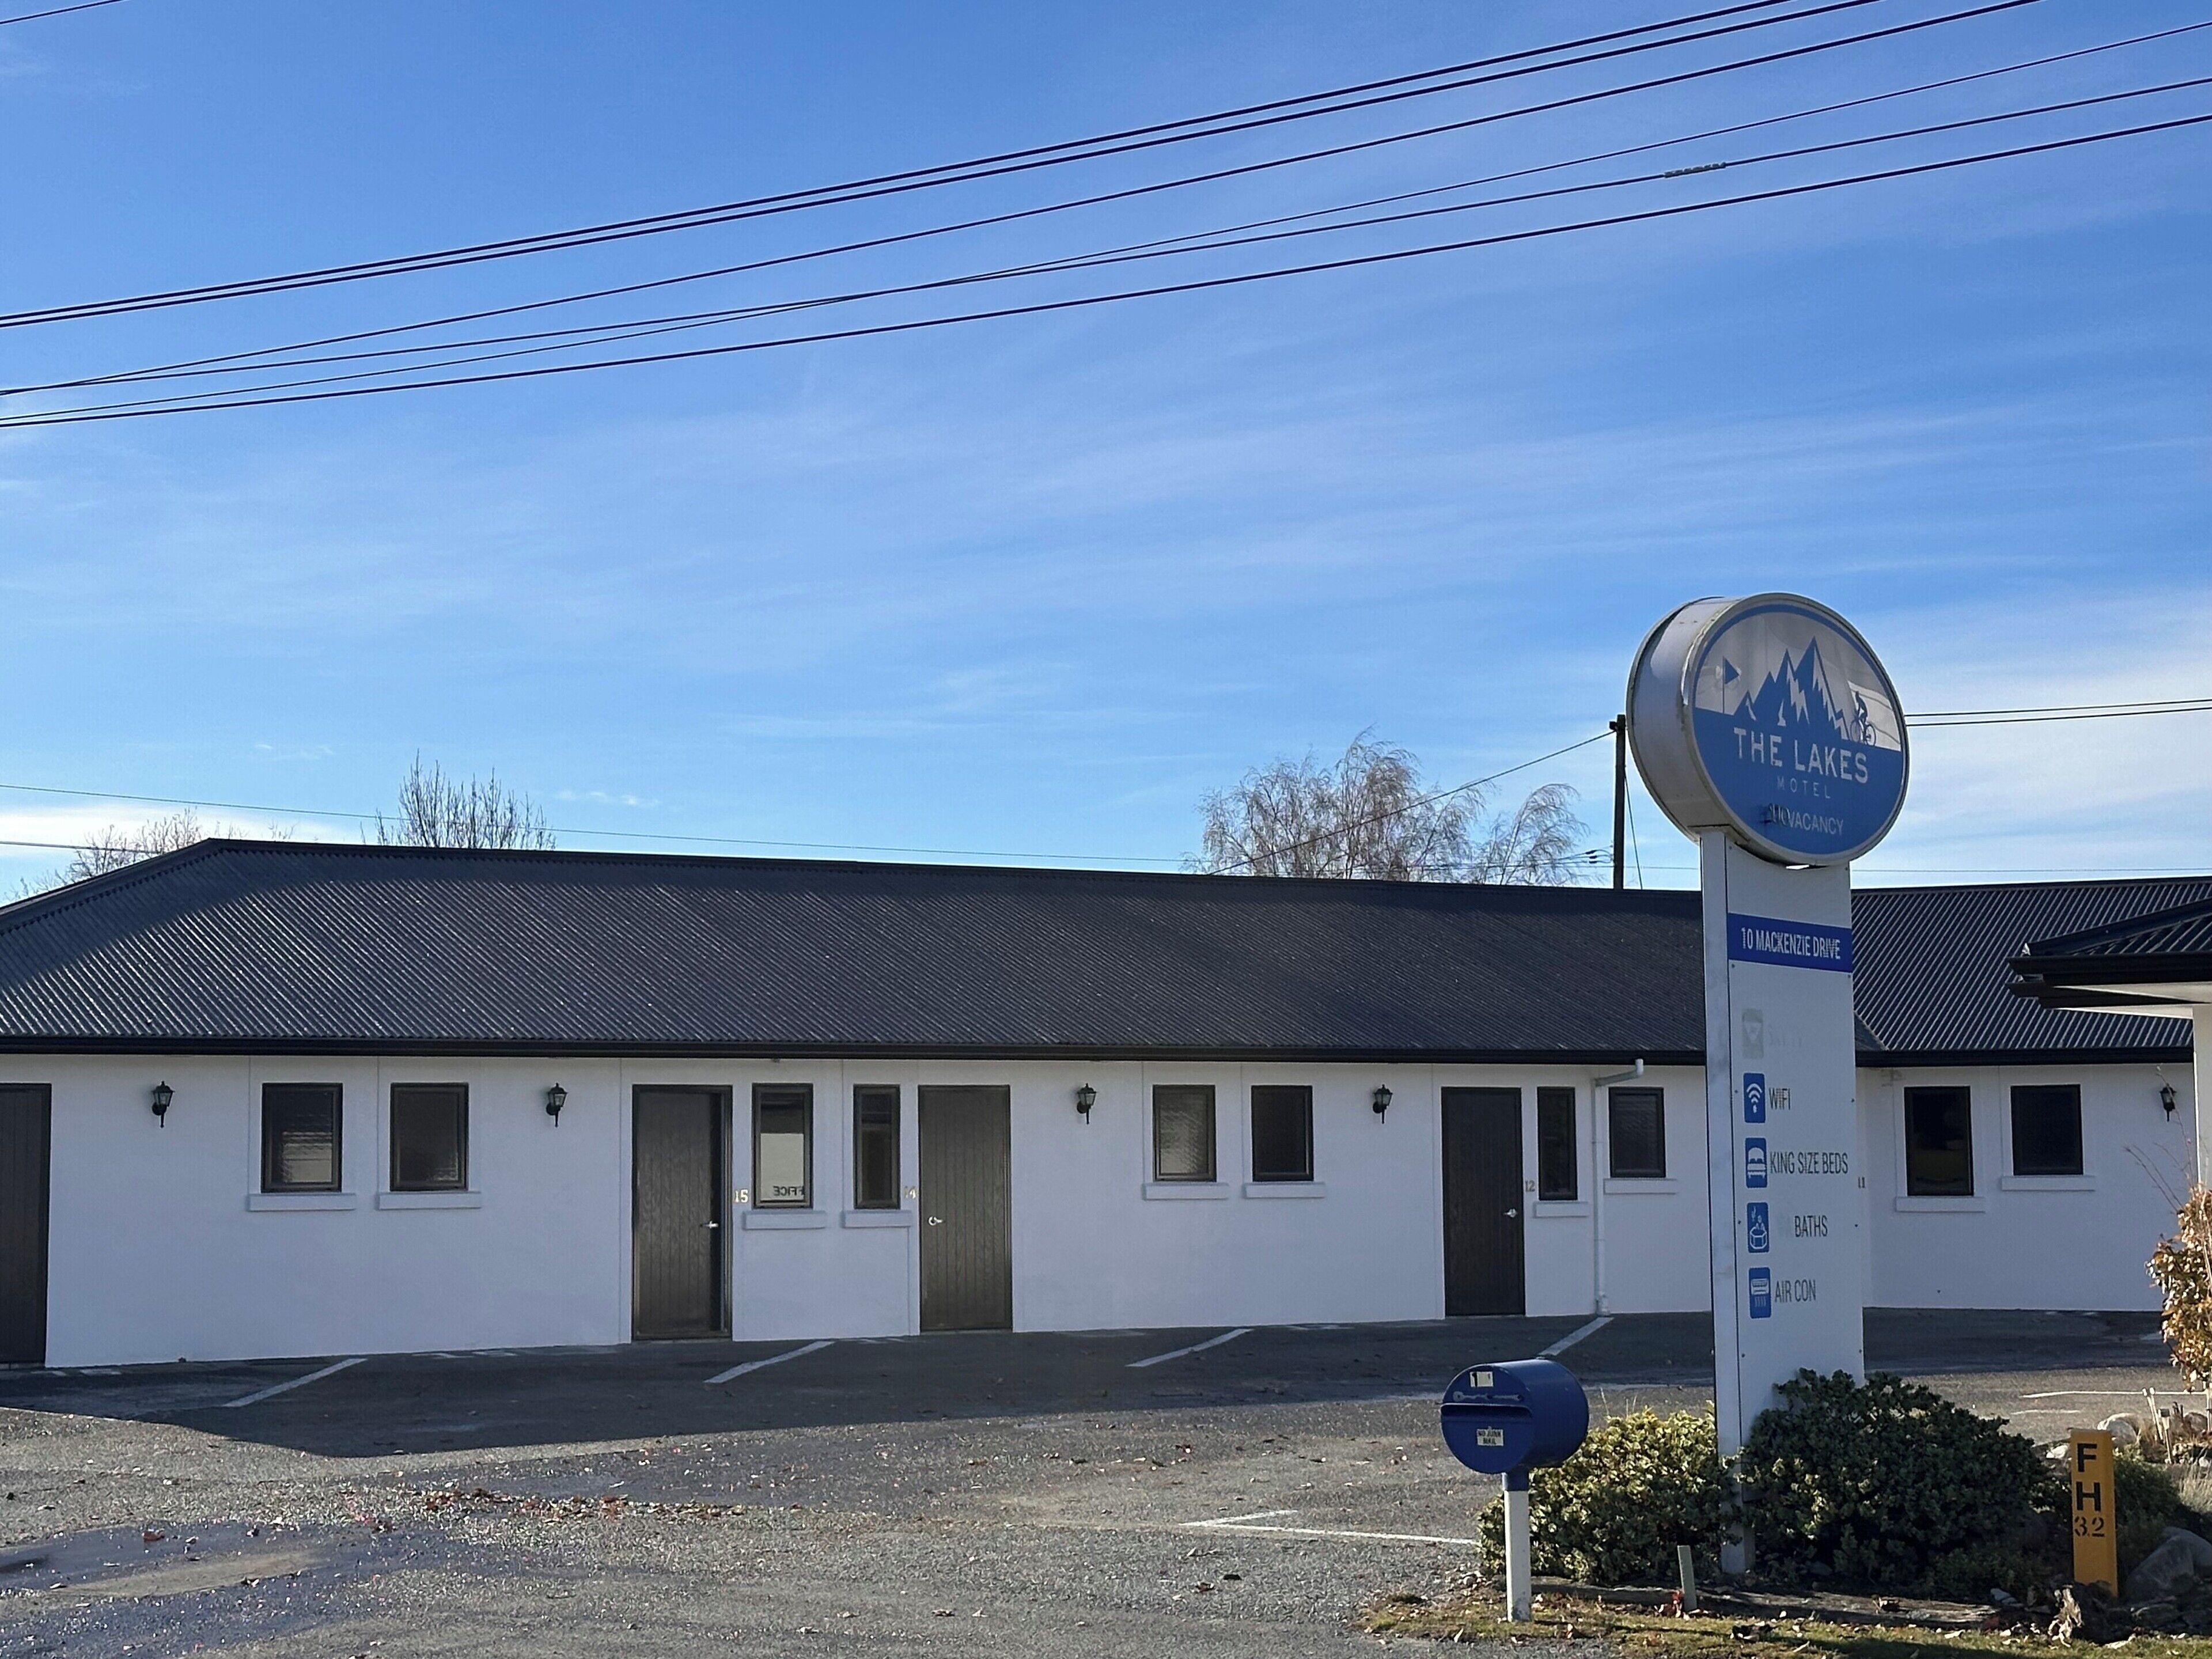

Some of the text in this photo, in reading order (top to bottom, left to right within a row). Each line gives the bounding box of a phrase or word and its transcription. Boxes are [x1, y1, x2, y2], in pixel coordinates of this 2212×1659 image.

[1734, 727, 1868, 783] THE LAKES
[1777, 776, 1831, 799] MOTEL
[1790, 810, 1844, 835] VACANCY
[1741, 927, 1841, 960] 10 MACKENZIE DRIVE
[1768, 1088, 1791, 1111] WIFI
[1770, 1151, 1848, 1175] KING SIZE BEDS
[734, 1189, 748, 1203] 15
[1525, 1180, 1536, 1192] 12
[1794, 1215, 1828, 1238] BATHS
[1775, 1279, 1816, 1303] AIR CON
